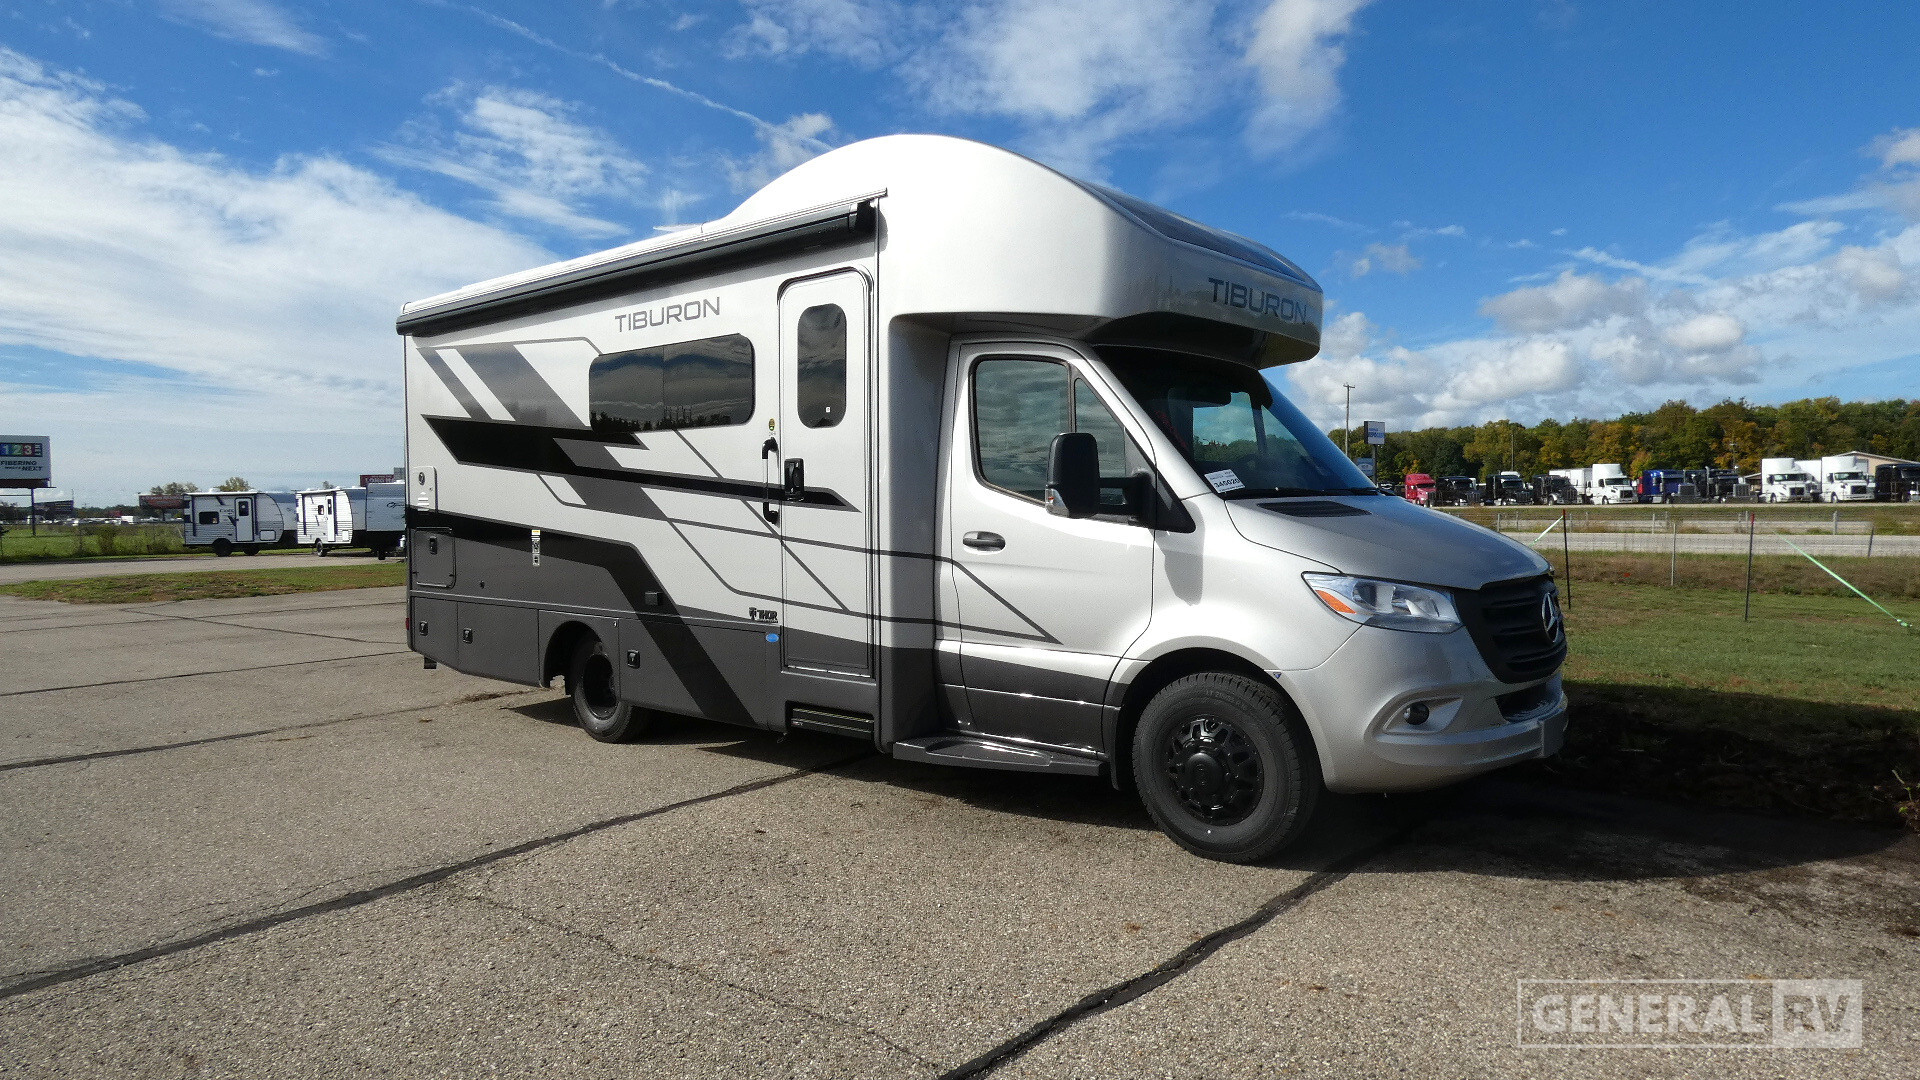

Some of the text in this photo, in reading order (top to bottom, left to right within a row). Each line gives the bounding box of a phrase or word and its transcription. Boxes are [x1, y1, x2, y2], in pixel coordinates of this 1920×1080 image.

[614, 297, 720, 332] TIBURON
[1208, 277, 1307, 325] TIBURON
[757, 609, 778, 620] THOR
